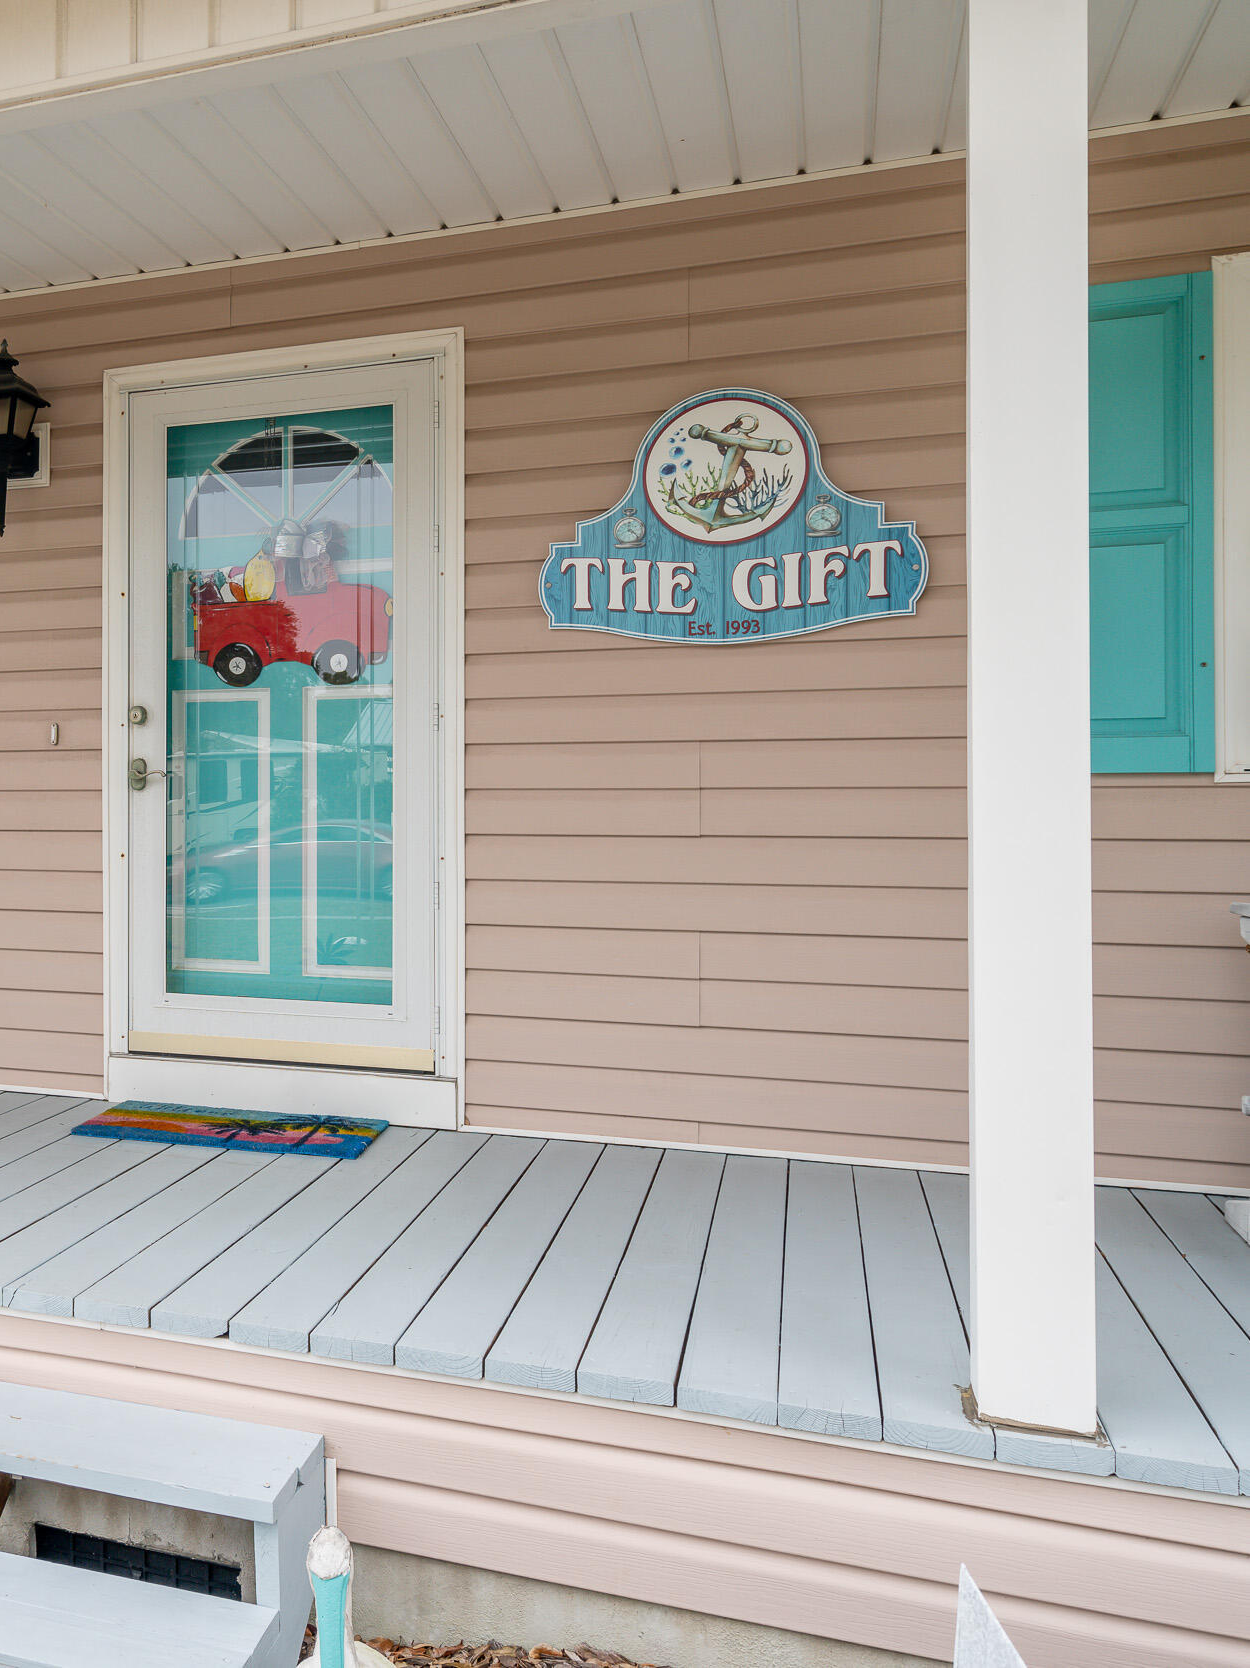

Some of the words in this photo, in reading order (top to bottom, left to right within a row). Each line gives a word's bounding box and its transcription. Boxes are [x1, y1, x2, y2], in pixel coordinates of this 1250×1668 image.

[560, 557, 698, 615] THE
[731, 540, 903, 612] GIFT
[687, 620, 716, 637] Est.
[724, 619, 761, 636] 1993
